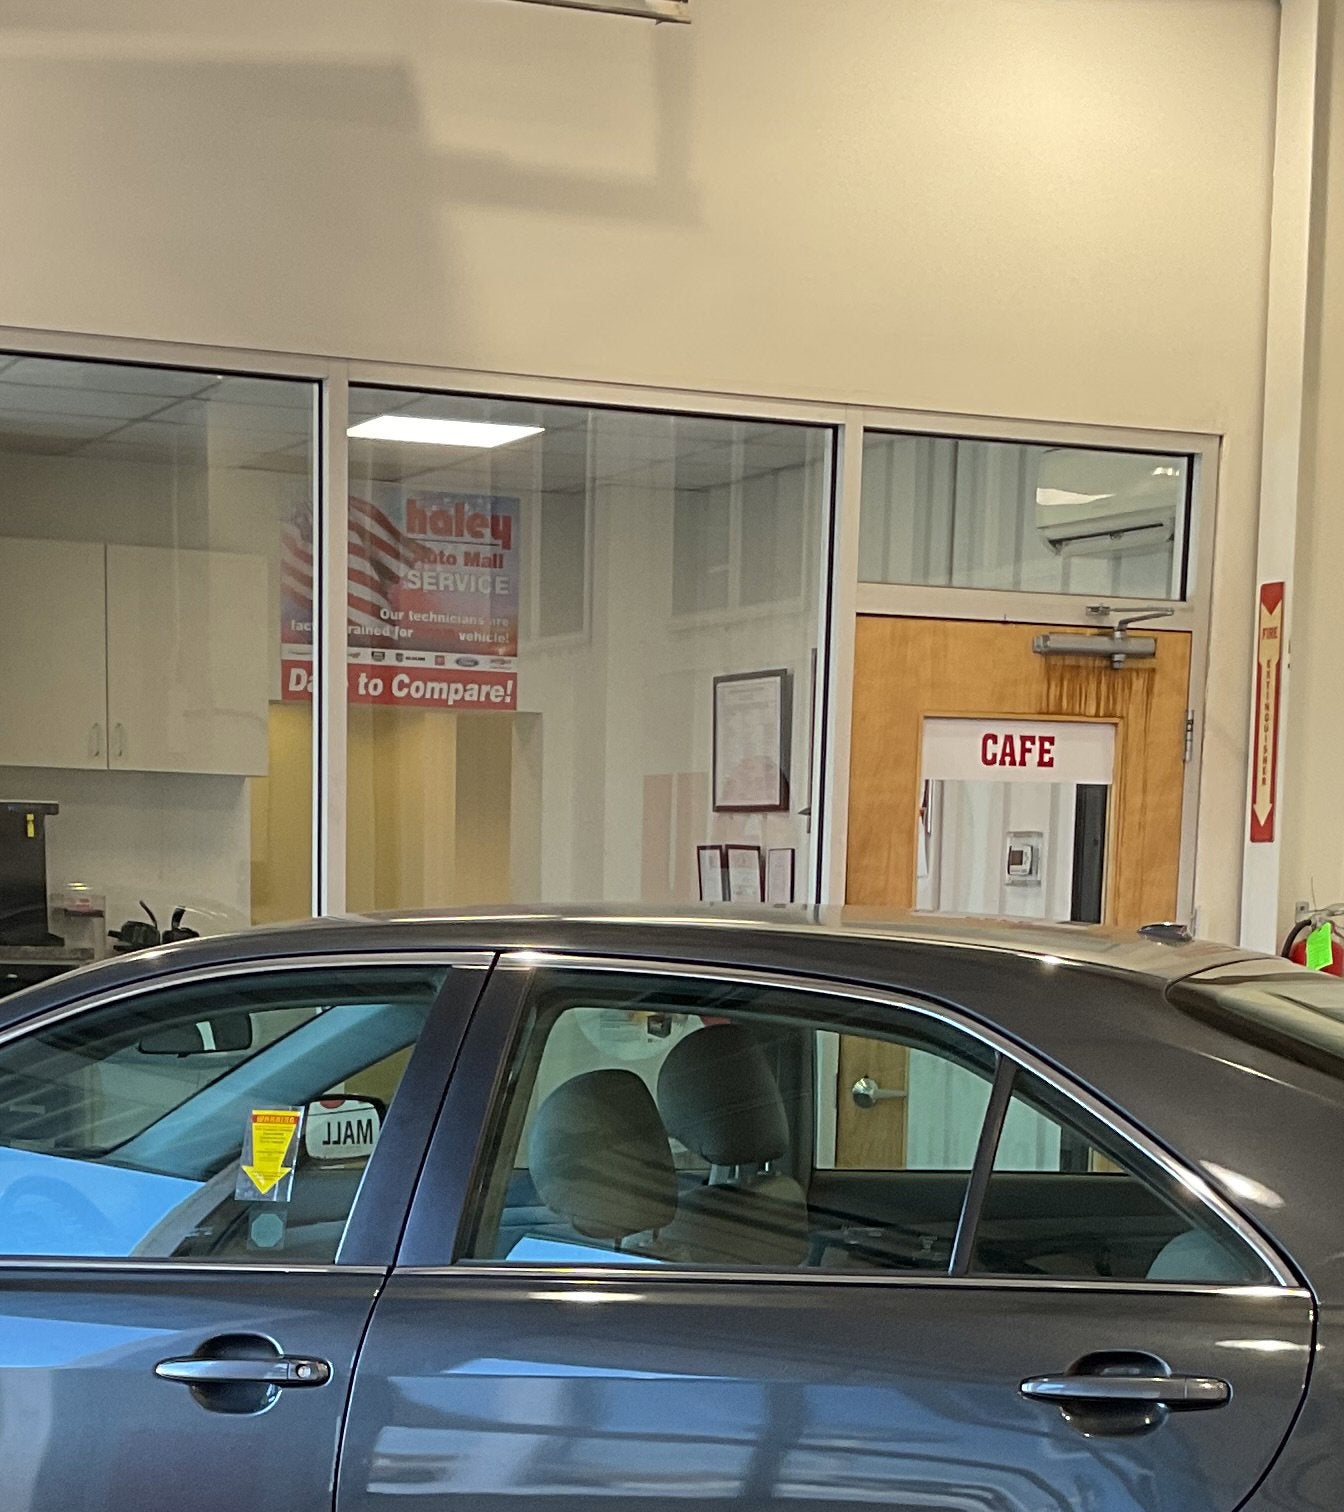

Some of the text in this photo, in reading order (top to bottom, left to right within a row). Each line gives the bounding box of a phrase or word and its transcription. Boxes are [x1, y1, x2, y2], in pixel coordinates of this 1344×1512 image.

[408, 498, 512, 550] haley
[464, 551, 504, 569] Mall
[407, 571, 509, 594] SERVICE
[380, 608, 404, 620] Our
[409, 611, 485, 625] technicians
[392, 626, 413, 640] for
[459, 632, 509, 644] vehicle!
[1262, 626, 1278, 640] FIRE
[358, 673, 383, 695] to
[392, 674, 513, 704] Compare!
[1261, 659, 1272, 786] EXTINGUISHER
[981, 733, 1055, 767] CAFE
